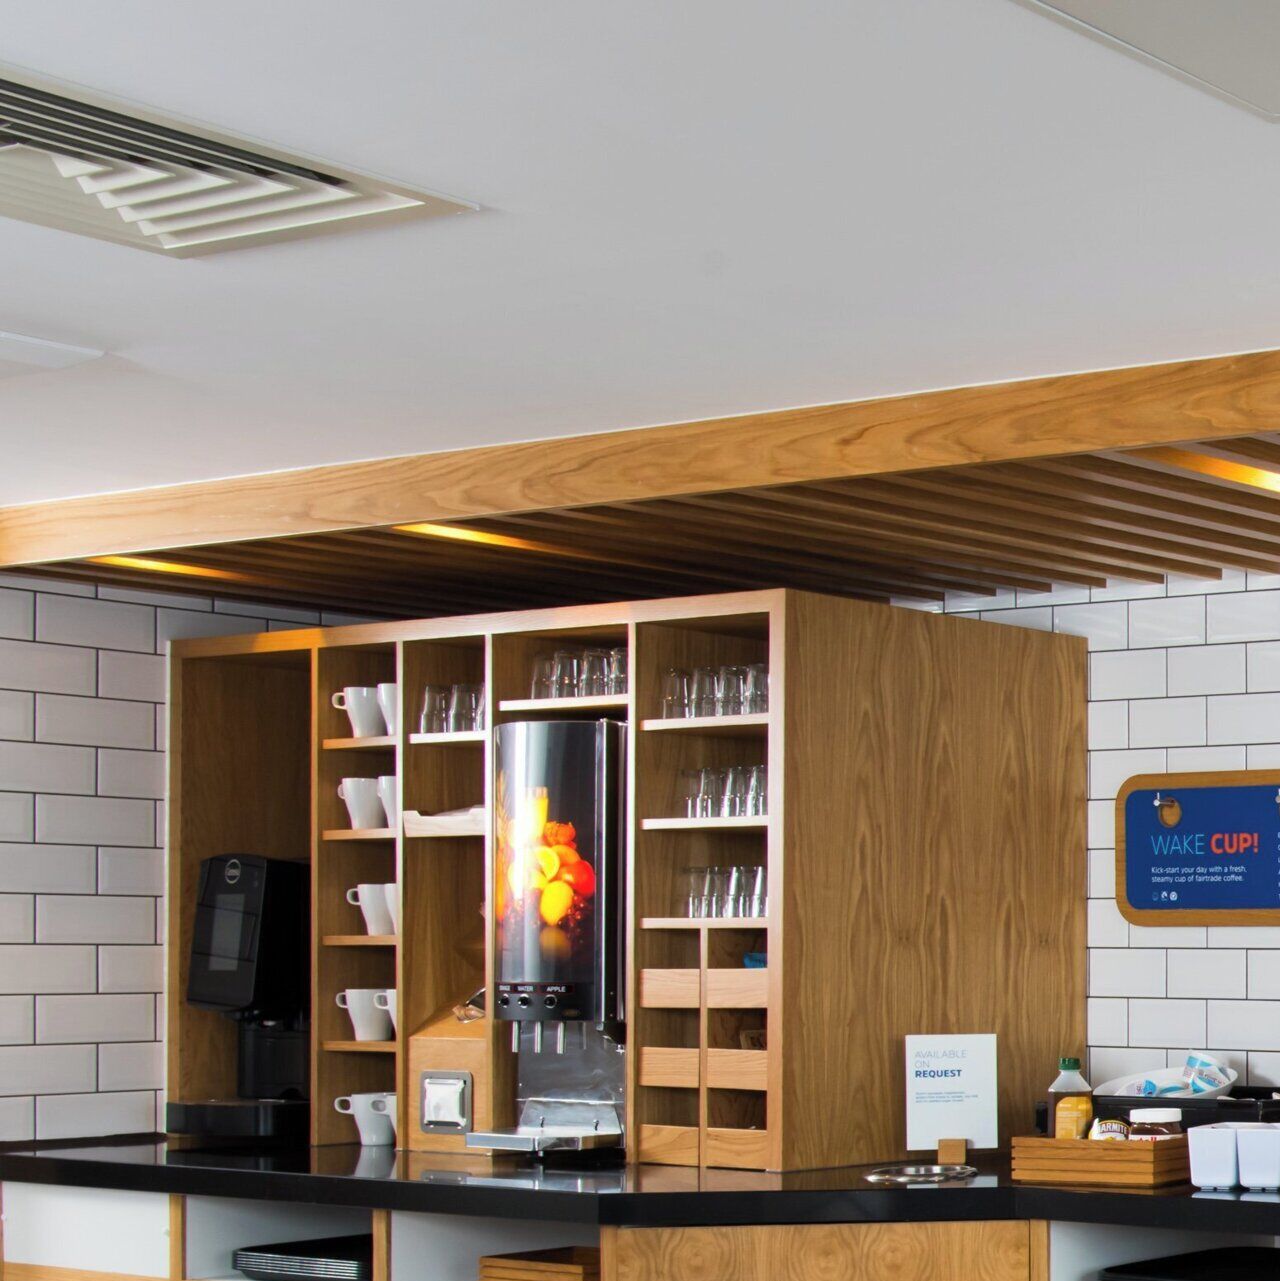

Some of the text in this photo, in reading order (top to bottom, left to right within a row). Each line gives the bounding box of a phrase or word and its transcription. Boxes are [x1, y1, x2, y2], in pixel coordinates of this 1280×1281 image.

[1150, 832, 1259, 855] WAKE CUP!
[1151, 866, 1180, 874] Kick-start
[1196, 866, 1207, 874] day
[914, 1049, 968, 1059] AVAILABLE
[914, 1060, 930, 1069] ON
[914, 1069, 962, 1078] REQUEST
[1099, 1121, 1128, 1135] ARMITE
